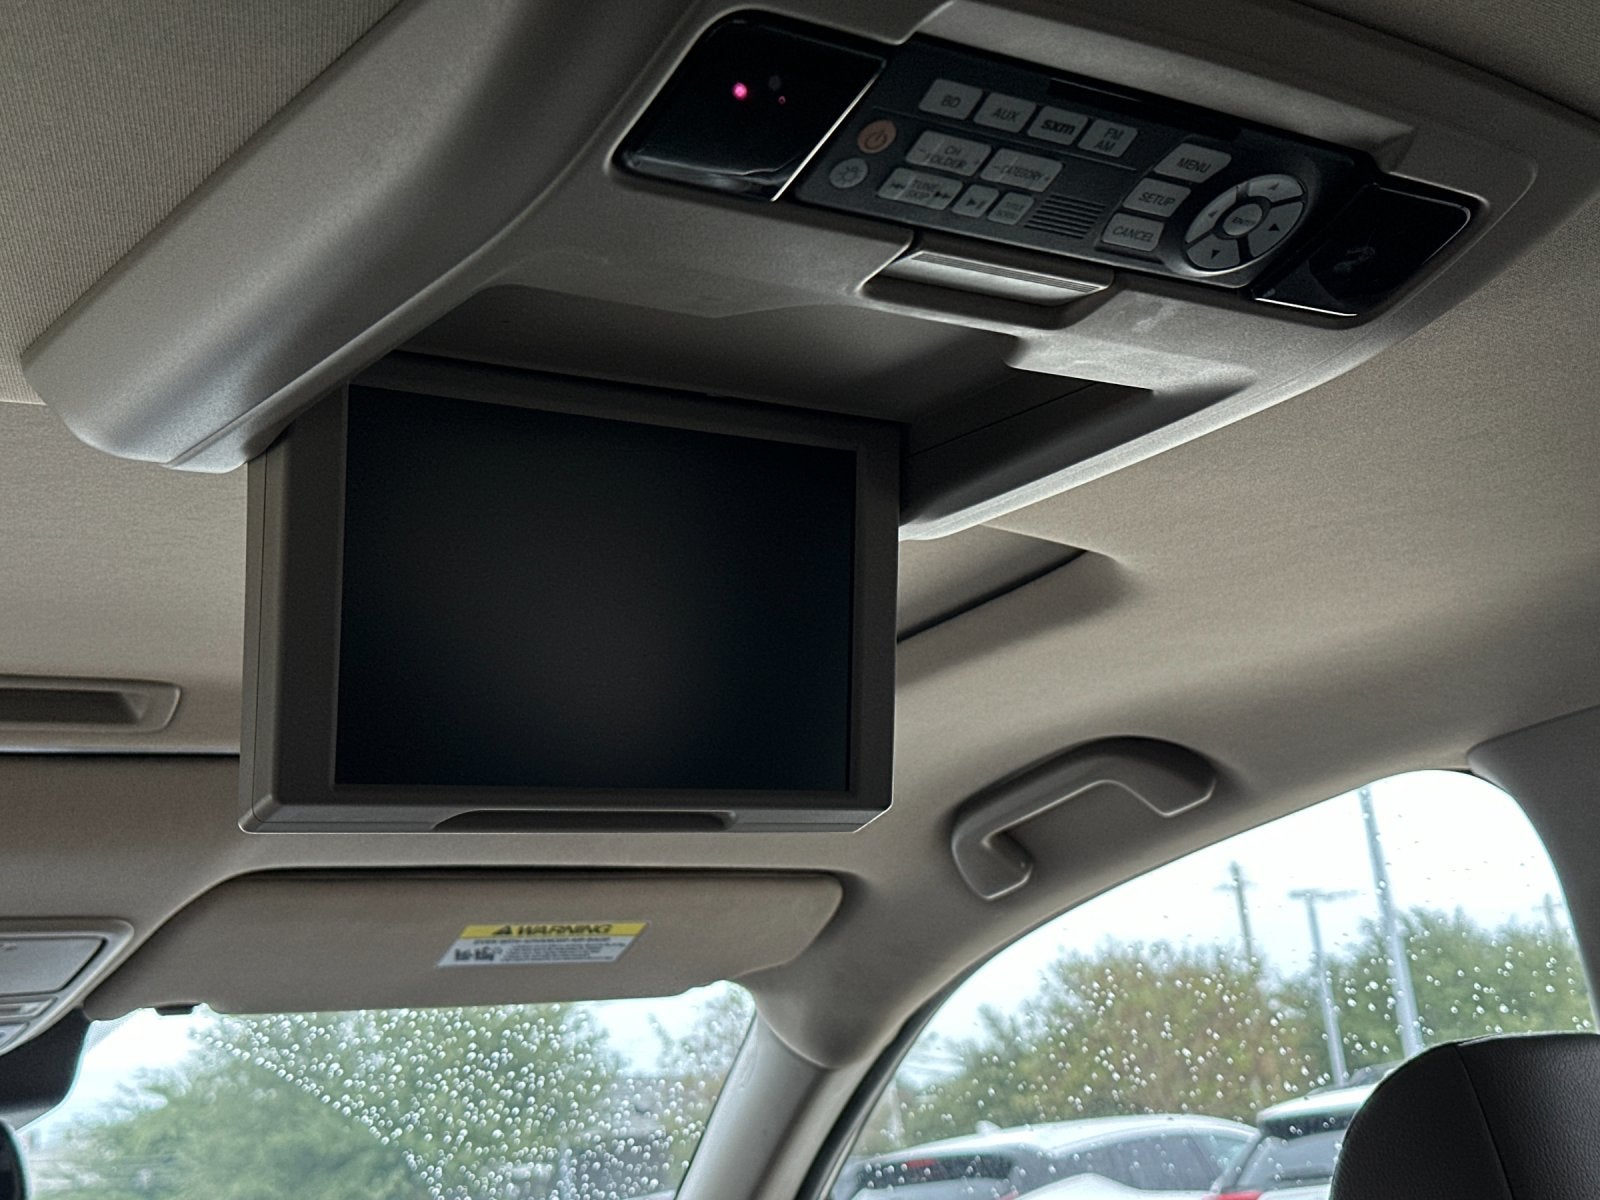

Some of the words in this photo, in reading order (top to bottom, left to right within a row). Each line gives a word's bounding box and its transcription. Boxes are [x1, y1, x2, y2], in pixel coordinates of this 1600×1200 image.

[941, 95, 961, 109] BD
[993, 108, 1018, 122] AUX
[1041, 119, 1075, 135] sxm
[1104, 127, 1124, 141] FM
[943, 145, 962, 156] CH
[1094, 140, 1116, 153] AM
[1177, 157, 1211, 173] MENU
[1139, 191, 1175, 207] SETUP
[1113, 226, 1154, 242] CANCEL
[517, 923, 613, 935] WARNING
